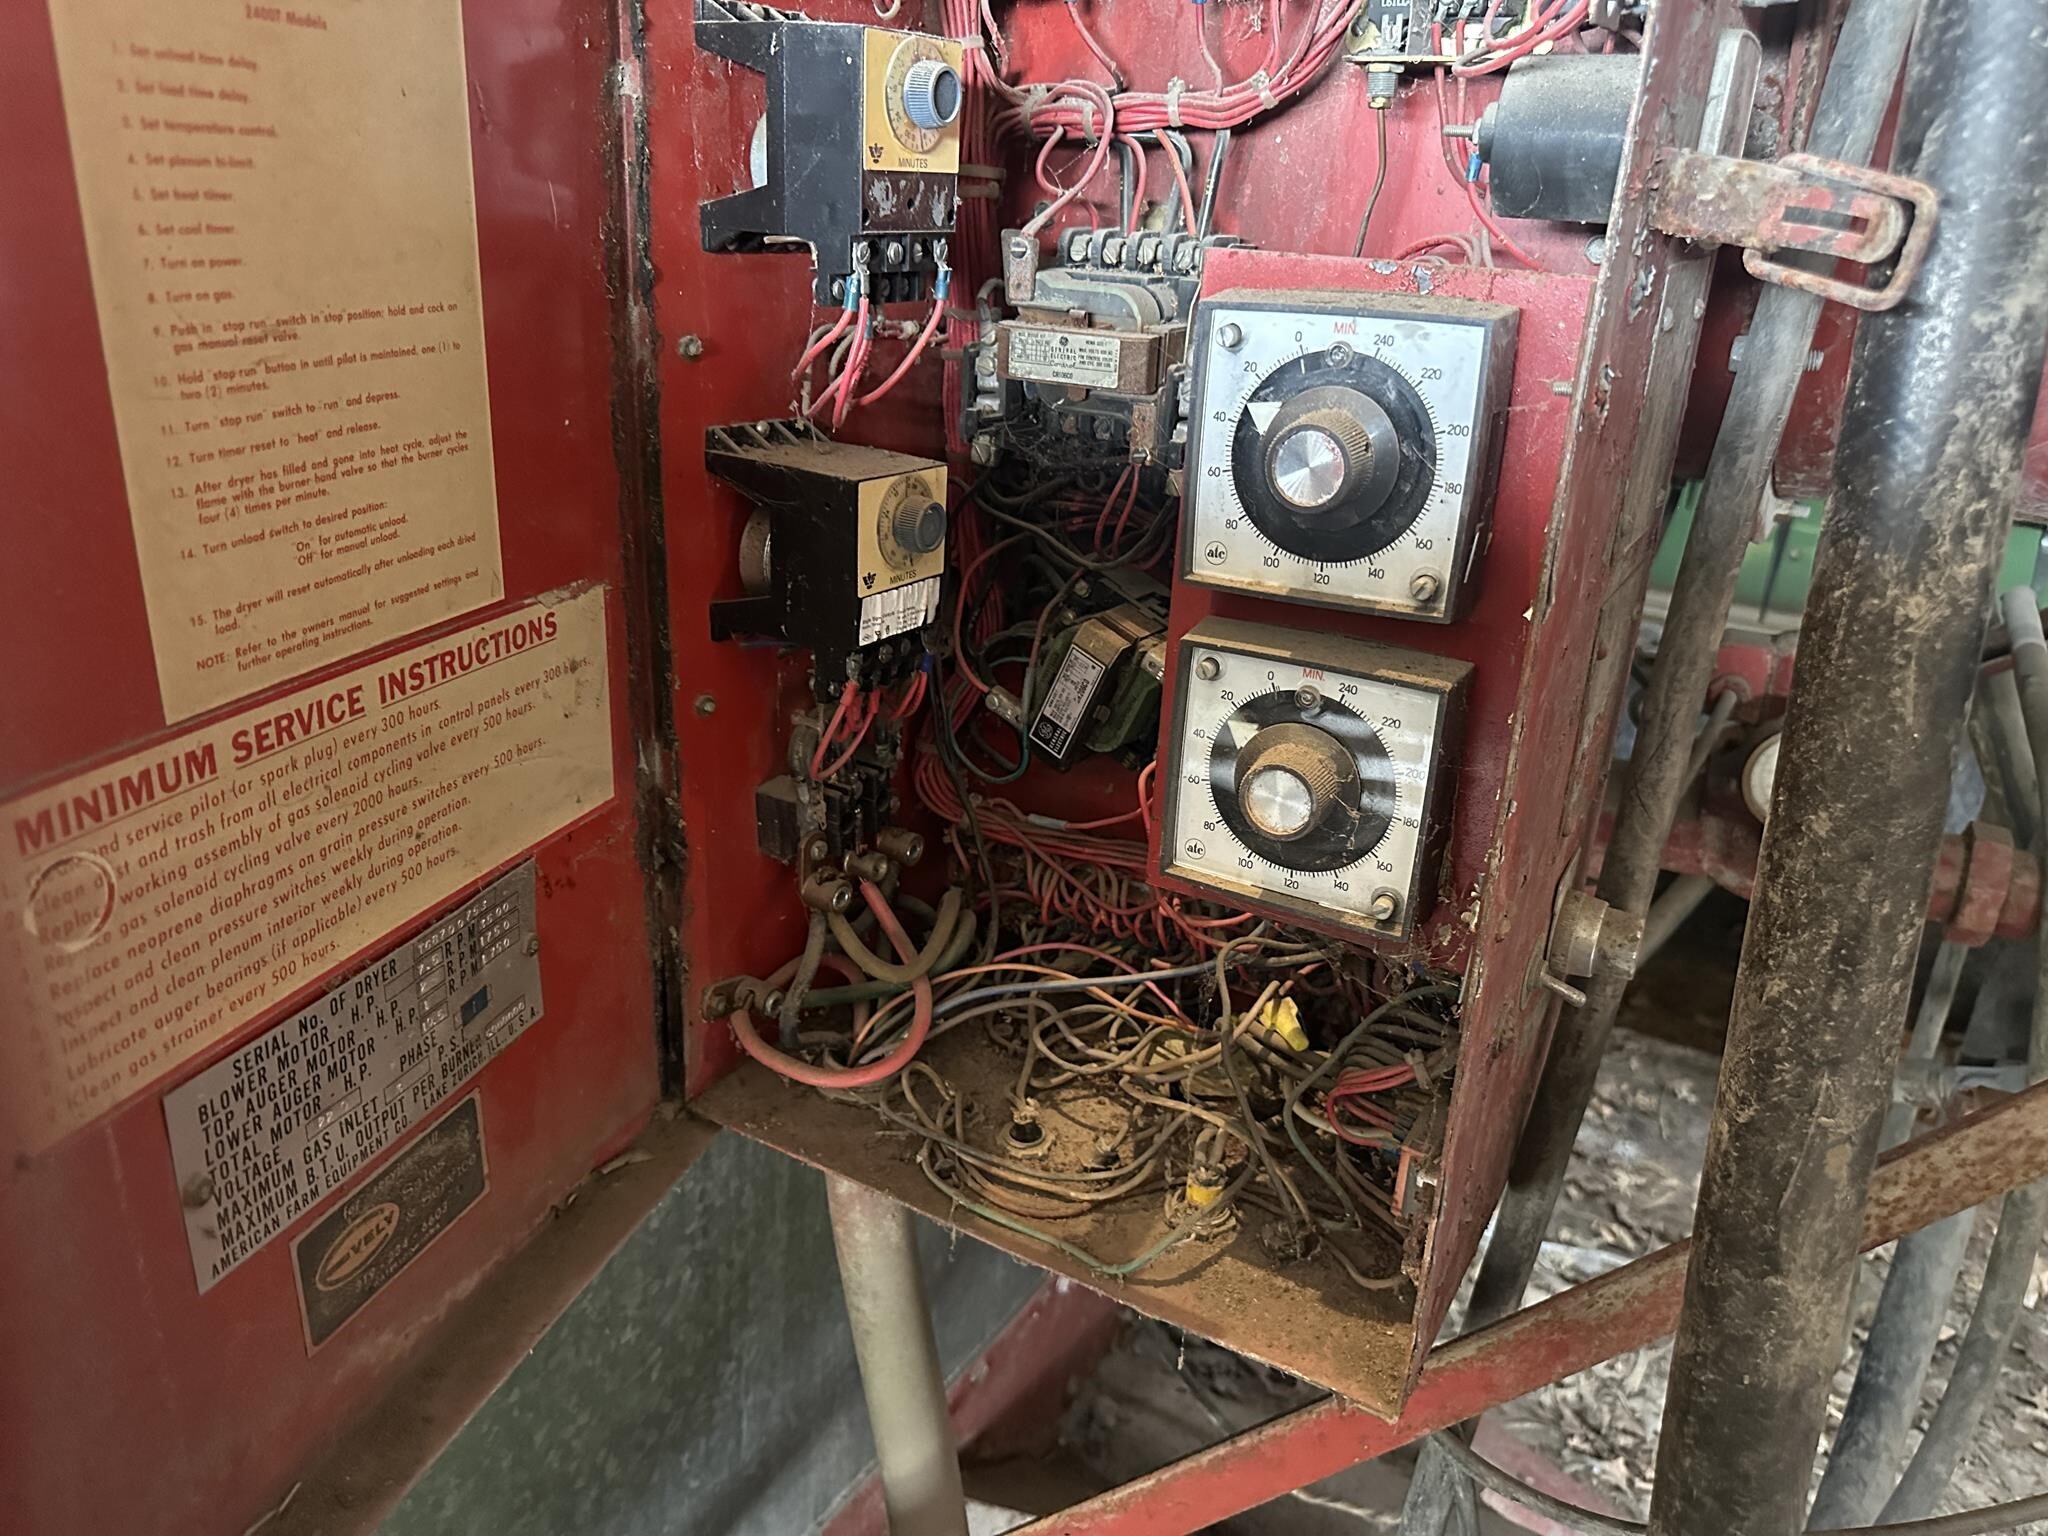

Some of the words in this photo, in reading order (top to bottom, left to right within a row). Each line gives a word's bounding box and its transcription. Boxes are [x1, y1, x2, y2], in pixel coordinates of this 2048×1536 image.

[898, 158, 928, 169] MINUTES
[1333, 321, 1358, 335] MIN.
[1295, 331, 1302, 343] 0
[1374, 335, 1395, 347] 240
[1050, 346, 1077, 355] GENERAL
[1050, 353, 1077, 361] ELECTRIC
[1244, 361, 1258, 373] 20
[1421, 368, 1442, 380] 220
[1213, 411, 1227, 423] 40
[1447, 425, 1469, 437] 200
[194, 481, 222, 495] After
[227, 474, 255, 491] dryer
[260, 469, 278, 481] has
[282, 461, 307, 477] filled
[311, 457, 328, 470] and
[333, 453, 354, 470] gone
[359, 449, 375, 460] into
[380, 444, 399, 456] heat
[428, 433, 451, 447] adjust
[455, 429, 467, 440] the
[1207, 466, 1222, 478] 60
[1444, 482, 1462, 495] 180
[315, 508, 348, 527] desired
[1225, 519, 1238, 530] 80
[1415, 538, 1433, 551] 160
[1263, 556, 1280, 568] 100
[212, 608, 232, 622] The
[235, 599, 262, 615] dryer
[266, 589, 284, 603] will
[287, 583, 311, 598] reset
[313, 565, 371, 590] automatically
[374, 558, 394, 571] after
[397, 546, 435, 564] unloading
[437, 539, 455, 551] each
[457, 532, 476, 545] dried
[889, 570, 917, 585] MINUTES
[1313, 572, 1330, 585] 120
[1368, 567, 1385, 580] 140
[196, 652, 230, 671] NOTE:
[235, 643, 262, 658] Refer
[267, 636, 277, 647] to
[281, 630, 297, 642] the
[302, 618, 335, 635] owners
[339, 604, 370, 622] manual
[375, 599, 386, 611] for
[391, 583, 430, 604] suggested
[433, 574, 462, 590] settings
[465, 568, 479, 579] and
[1267, 671, 1274, 681] 0
[1302, 668, 1325, 682] MIN.
[1221, 690, 1234, 701] 20
[1339, 683, 1358, 696] 240
[1382, 717, 1401, 729] 220
[14, 743, 218, 857] MINIMUM
[232, 685, 367, 764] SERVICE
[378, 611, 558, 704] INSTRUCTIONS
[1049, 728, 1063, 749] GENERAL
[1193, 729, 1206, 739] 40
[1054, 730, 1068, 753] ELECTRIC
[126, 810, 183, 846] service
[190, 790, 225, 820] pilot
[232, 779, 252, 799] (or
[260, 755, 299, 787] spark
[304, 737, 338, 767] plug)
[343, 726, 377, 749] every
[382, 712, 404, 732] 300
[408, 700, 441, 720] hours.
[138, 840, 168, 868] and
[175, 824, 215, 851] trash
[220, 807, 253, 830] from
[258, 790, 276, 813] all
[283, 761, 343, 800] electrical
[348, 732, 417, 770] components
[421, 725, 431, 737] in
[438, 702, 474, 730] control
[477, 688, 510, 715] panels
[515, 678, 540, 696] every
[1406, 767, 1426, 781] 200
[1187, 775, 1200, 785] 60
[119, 865, 188, 905] working
[194, 827, 262, 870] assembly
[268, 813, 282, 833] of
[288, 806, 310, 827] gas
[315, 773, 368, 811] solenoid
[374, 755, 413, 783] cycling
[417, 743, 446, 762] valve
[450, 725, 480, 746] every
[483, 713, 502, 731] 500
[505, 701, 536, 721] hours.
[1204, 821, 1216, 832] 80
[1402, 817, 1419, 830] 180
[127, 911, 203, 959] neoprene
[210, 865, 294, 916] diaphragms
[299, 853, 314, 869] on
[319, 834, 353, 861] grain
[358, 806, 408, 841] pressure
[412, 779, 458, 811] switches
[462, 764, 490, 784] every
[494, 749, 513, 769] 500
[516, 736, 546, 757] hours.
[153, 872, 218, 917] solenoid
[224, 850, 270, 882] cycling
[275, 828, 311, 855] valve
[315, 811, 349, 834] every
[352, 791, 384, 816] 2000
[387, 778, 423, 799] hours.
[1238, 857, 1254, 870] 100
[1376, 861, 1393, 873] 160
[1283, 878, 1299, 890] 120
[1333, 880, 1350, 892] 140
[124, 960, 154, 990] and
[160, 939, 200, 970] clean
[208, 902, 268, 946] pressure
[272, 871, 327, 908] switches
[331, 845, 373, 876] weekly
[377, 826, 414, 852] during
[417, 795, 471, 830] operation.
[231, 1030, 290, 1079] SERIAL
[298, 1014, 324, 1036] No.
[329, 991, 347, 1016] OF
[354, 958, 397, 999] DRYER
[198, 1066, 268, 1125] BLOWER
[277, 1026, 330, 1073] MOTOR
[202, 1110, 235, 1145] TOP
[246, 1069, 298, 1118] AUGER
[306, 1030, 356, 1076] MOTOR
[205, 1114, 263, 1167] LOWER
[273, 1074, 322, 1121] AUGER
[327, 1036, 376, 1083] MOTOR
[213, 1145, 282, 1208] VOLTAGE
[400, 1030, 438, 1072] PHASE
[208, 1140, 262, 1186] TOTAL
[270, 1095, 322, 1145] MOTOR
[216, 1158, 295, 1231] MAXIMUM
[303, 1131, 332, 1165] GAS
[338, 1096, 378, 1138] INLET
[220, 1178, 299, 1251] MAXIMUM
[355, 1095, 407, 1148] OUTPUT
[412, 1073, 436, 1103] PER
[211, 1214, 281, 1280] AMERICAN
[285, 1185, 320, 1220] FARM
[325, 1130, 389, 1189] EQUIPMENT
[394, 1115, 412, 1134] CO.
[423, 1081, 448, 1111] LAKE
